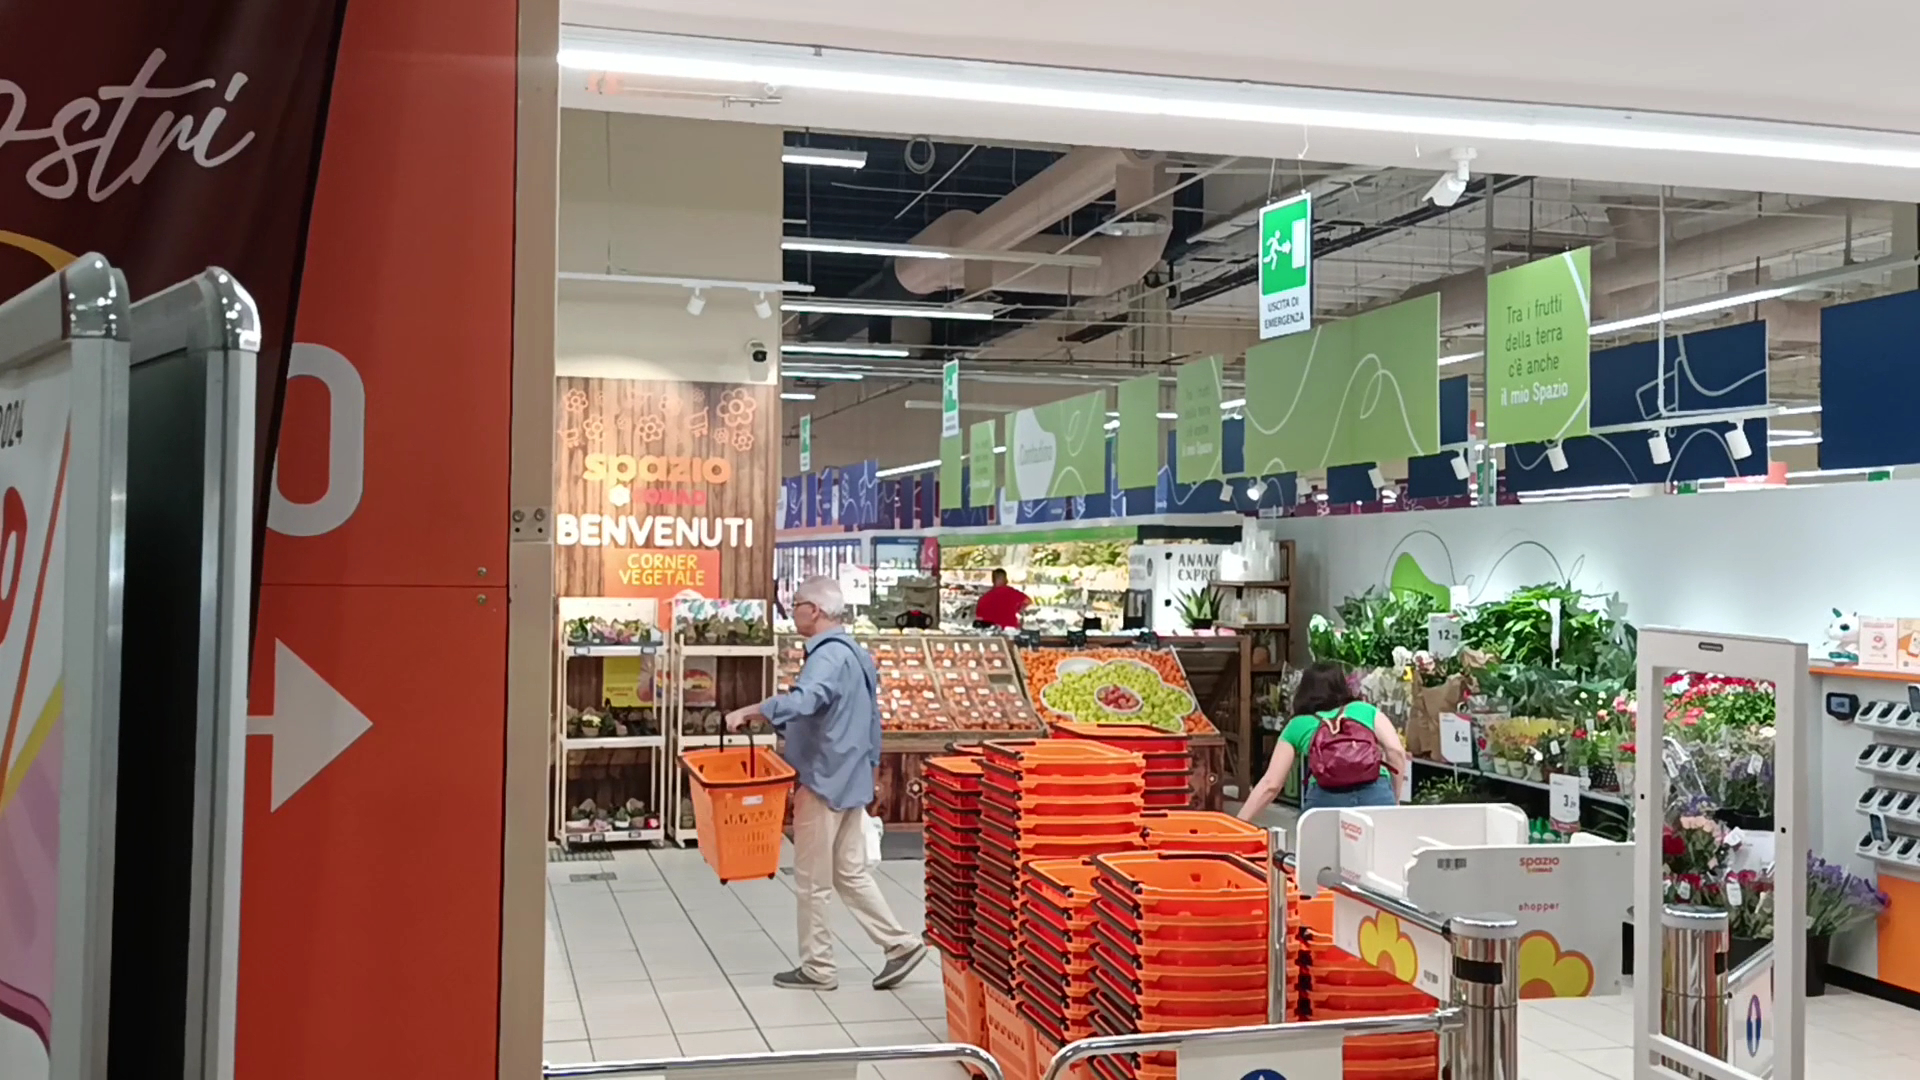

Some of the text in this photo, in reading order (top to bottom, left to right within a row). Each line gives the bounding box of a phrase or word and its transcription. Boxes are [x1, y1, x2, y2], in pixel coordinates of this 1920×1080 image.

[1267, 296, 1299, 312] USCITA DI
[1506, 305, 1523, 324] Tra
[1534, 293, 1562, 318] frutti
[1264, 311, 1305, 329] EMERGENZA
[1505, 326, 1563, 352] della terra
[1508, 352, 1560, 378] c'è anche
[1500, 377, 1569, 406] il mio Spazio
[0, 399, 25, 449] 024
[582, 452, 732, 487] spazio
[556, 512, 754, 548] BENVENUTI
[627, 553, 698, 570] CORNER
[618, 569, 706, 586] VEGETALE
[1519, 857, 1560, 868] spazio
[1518, 902, 1560, 912] shopper
